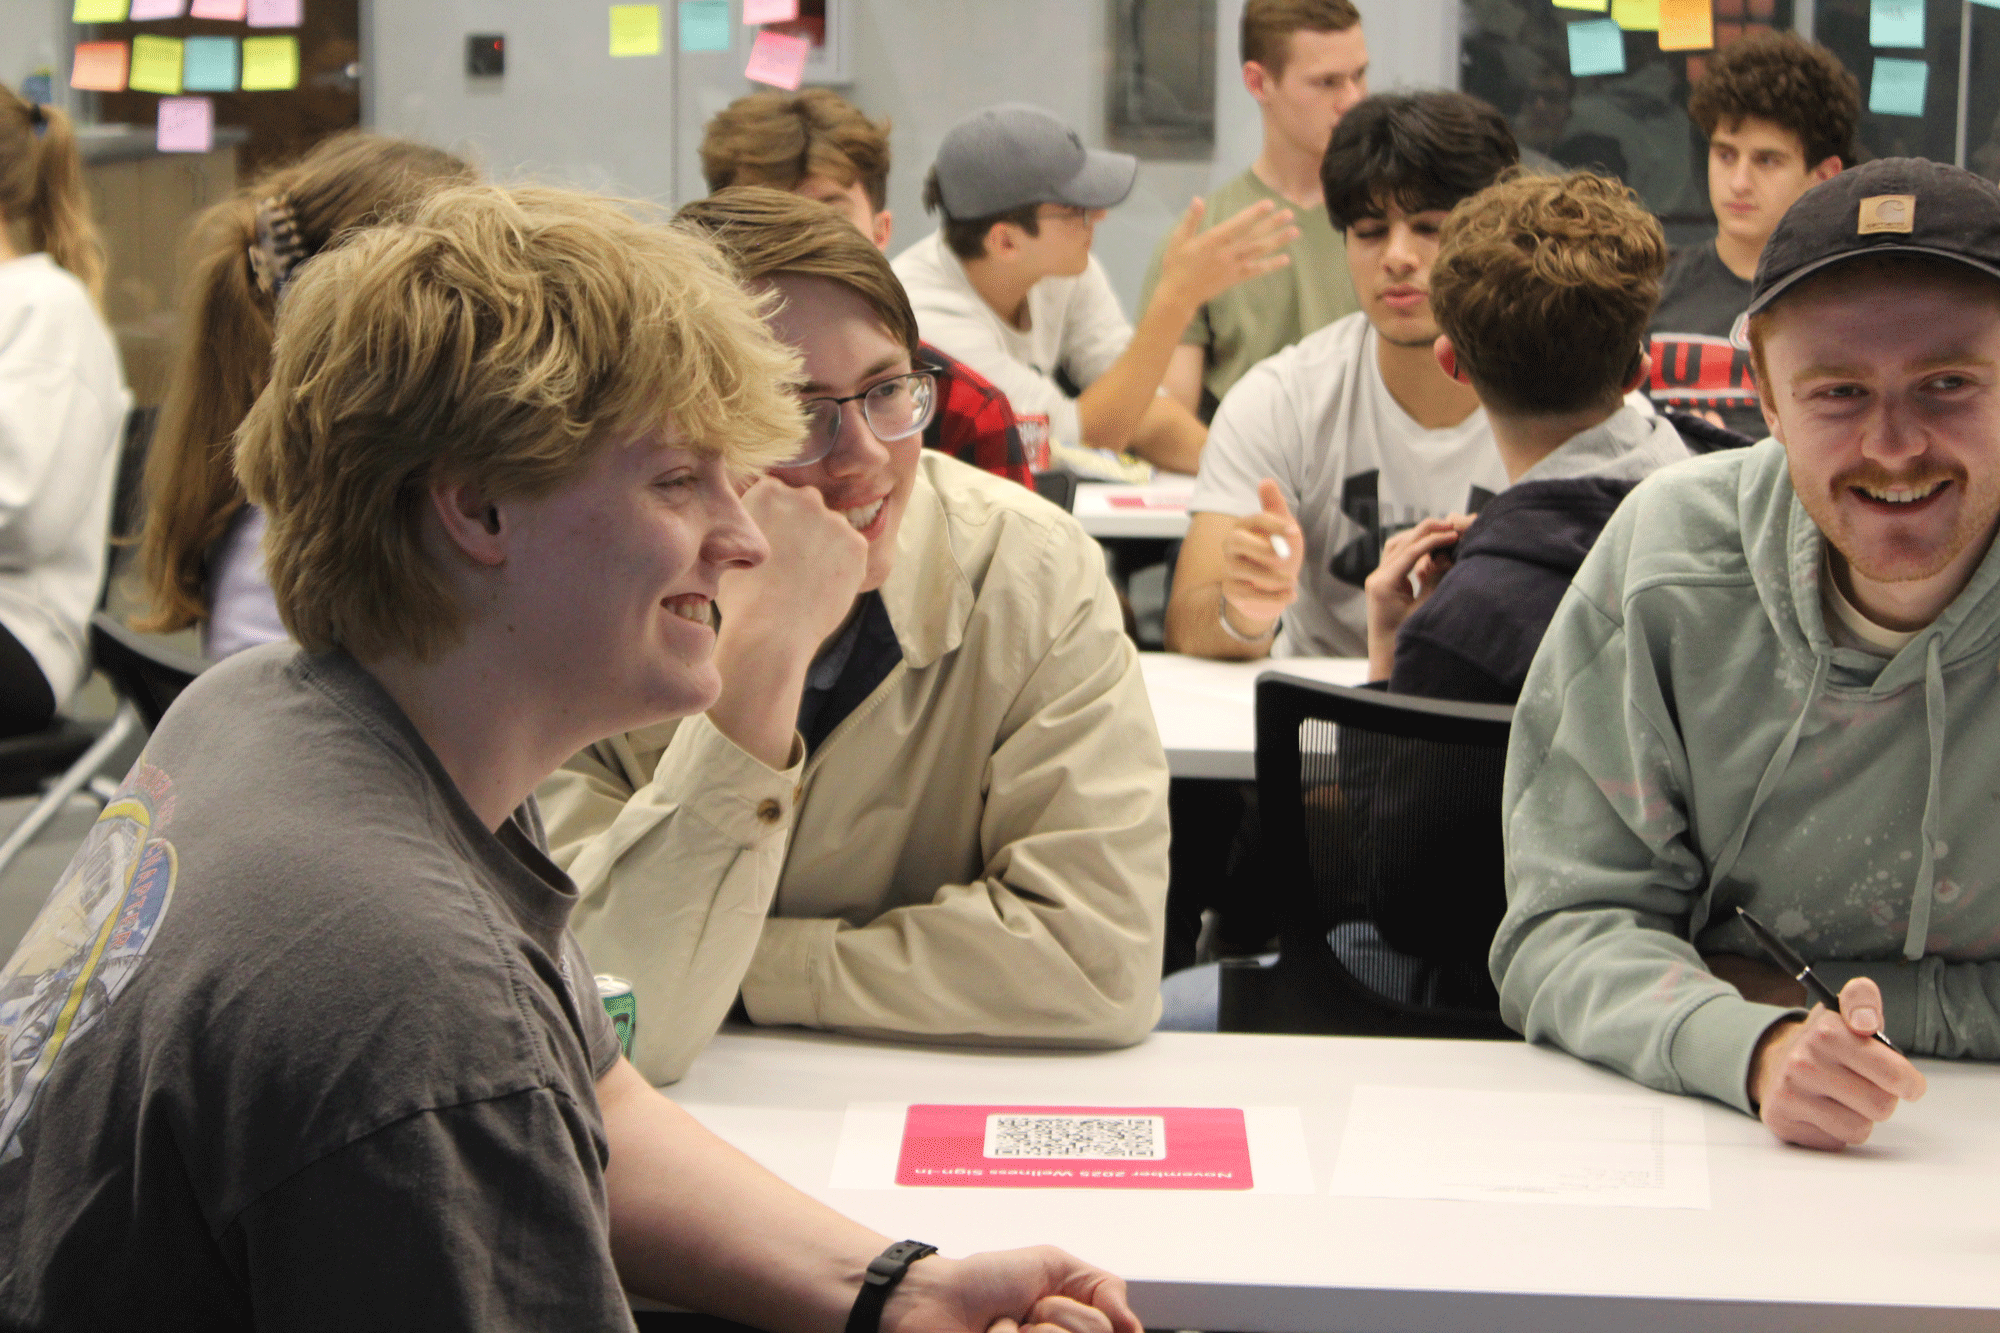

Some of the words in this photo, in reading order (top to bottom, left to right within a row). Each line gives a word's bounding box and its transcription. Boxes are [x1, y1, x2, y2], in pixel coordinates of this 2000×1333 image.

[108, 838, 167, 950] CHAPTER
[914, 1167, 983, 1176] Sign-In
[989, 1167, 1074, 1178] Wellness
[1079, 1168, 1126, 1178] 2025
[1132, 1169, 1233, 1179] November
